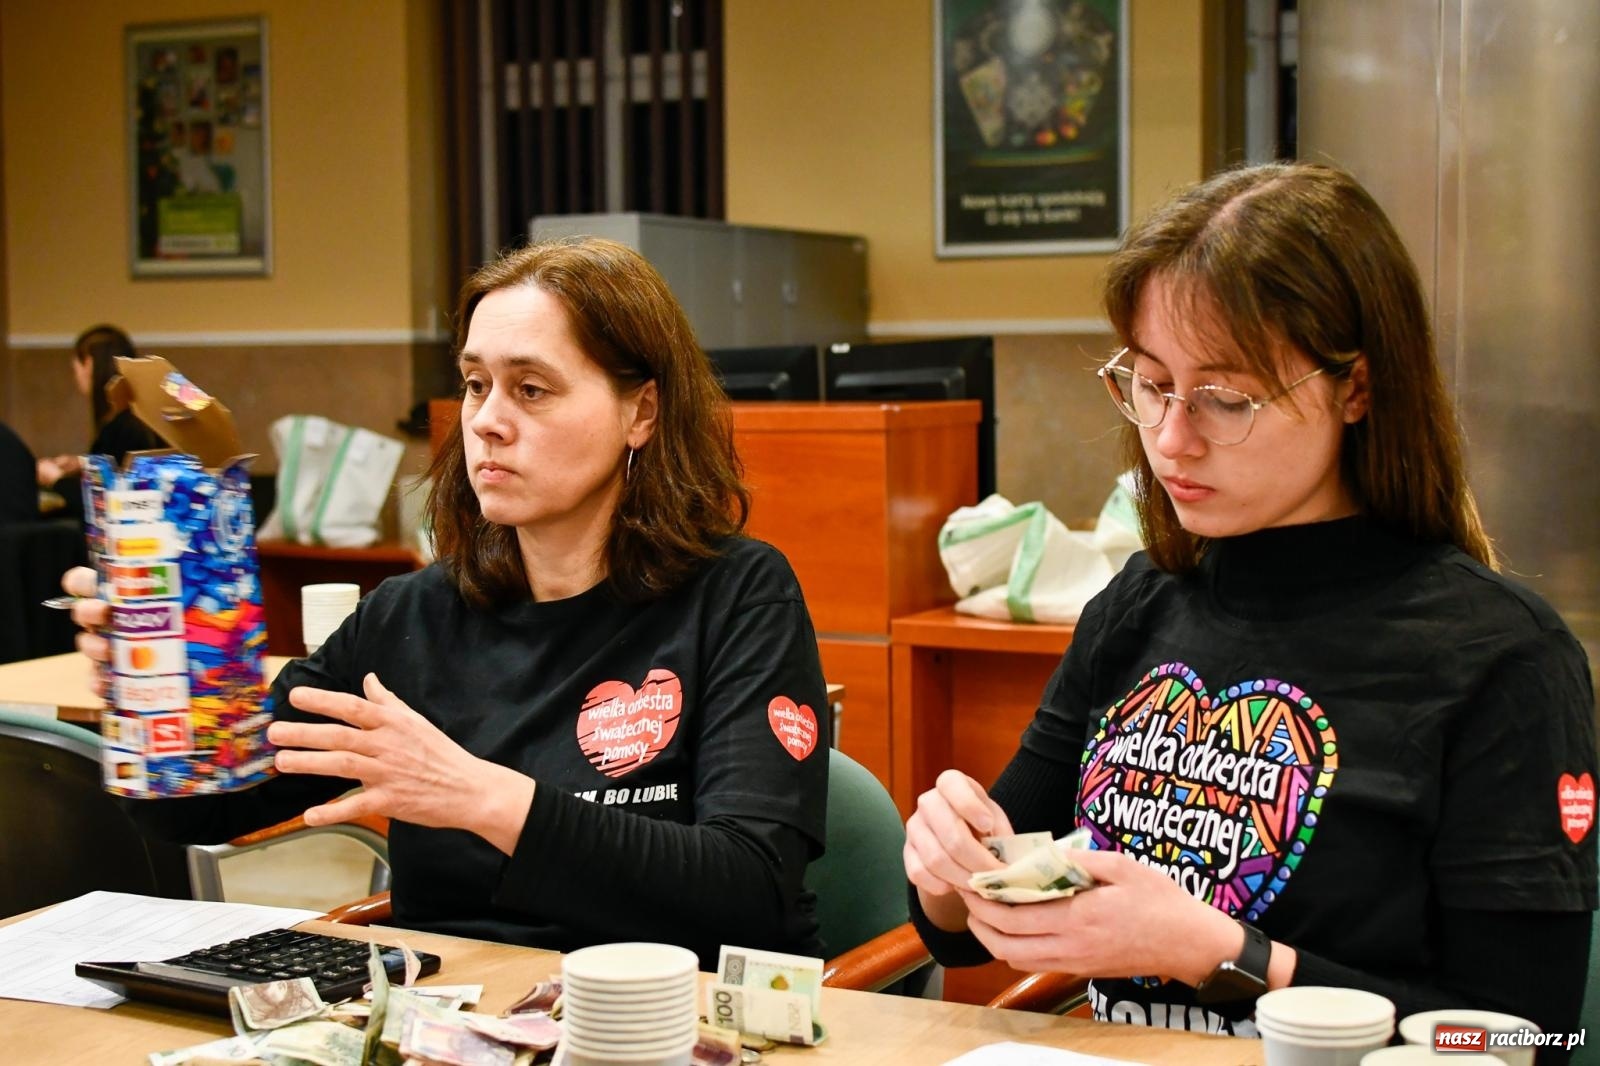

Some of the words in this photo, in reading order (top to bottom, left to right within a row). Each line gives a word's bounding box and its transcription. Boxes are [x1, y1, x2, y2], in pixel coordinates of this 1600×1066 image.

[588, 697, 625, 720] wielka
[627, 688, 673, 715] orkiestra
[592, 714, 663, 744] świątecznej
[601, 740, 648, 765] pomocy
[1105, 714, 1177, 773] wielka
[1178, 729, 1281, 800] orkiestra
[603, 788, 630, 805] BO
[632, 783, 678, 804] LUBIĘ
[1098, 772, 1247, 880] świątecznej
[715, 991, 734, 1024] 100
